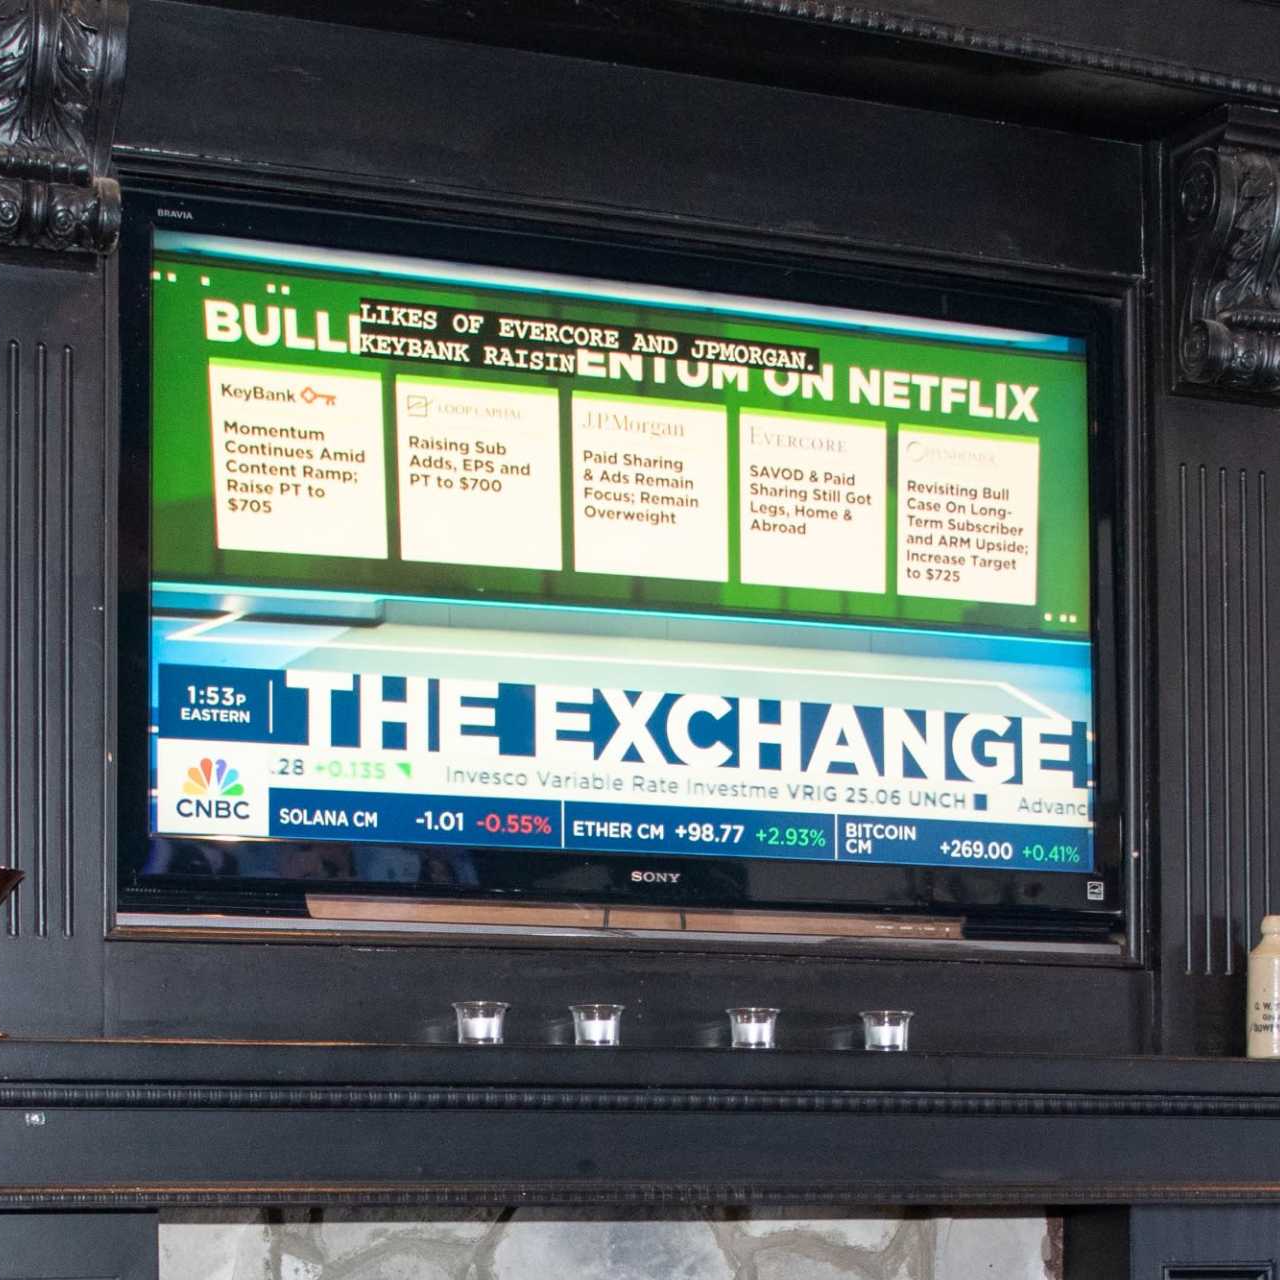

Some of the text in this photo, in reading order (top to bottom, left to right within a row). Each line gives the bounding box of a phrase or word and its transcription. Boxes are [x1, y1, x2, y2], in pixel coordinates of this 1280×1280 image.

[157, 208, 193, 220] BRAVIA
[359, 303, 815, 370] LIKES OF EVERCORE AND JPMORGAN.
[360, 333, 575, 374] KEYBANK RAISIN
[221, 383, 296, 404] KeyBank
[849, 366, 1039, 422] NETFLIX
[224, 420, 325, 441] Momentum
[225, 440, 366, 464] Continues Amid
[409, 436, 506, 456] Raising Sub
[226, 459, 358, 484] Content Ramp;
[410, 454, 531, 477] Adds, EPS and
[583, 450, 684, 473] Paid Sharing
[410, 473, 502, 494] PT to $700
[583, 469, 694, 490] & Ads Remain
[749, 464, 856, 486] SAVOD & Paid
[227, 479, 325, 499] Raise PT to
[584, 488, 699, 508] Focus; Remain
[749, 483, 872, 506] Sharing Still Got
[907, 480, 1010, 501] Revisiting Bull
[227, 498, 272, 514] $705
[584, 505, 676, 526] Overweight
[749, 501, 853, 521] Legs, Home &
[907, 499, 1012, 520] Case On Long-
[750, 519, 807, 535] Abroad
[907, 515, 1024, 537] Term Subscriber
[907, 533, 1029, 556] and ARM Upside;
[907, 550, 1017, 573] Increase Target
[907, 567, 961, 583] to $725
[181, 708, 250, 724] EASTERN
[287, 670, 1074, 787] THE EXCHANGE
[446, 765, 528, 787] Invesco
[536, 771, 624, 792] Variable
[633, 776, 679, 794] Rate
[687, 779, 779, 800] Investme
[787, 783, 838, 802] VRIG
[845, 787, 901, 807] 25.06
[908, 790, 966, 810] UNCH
[1018, 796, 1088, 817] Advanc
[176, 799, 250, 820] CNBC
[280, 808, 552, 835] SOLANA CM -1.01 -0.55%
[573, 820, 826, 848] ETHER CM +98.77 +2.93%
[845, 824, 916, 842] BITCOIN
[845, 839, 872, 855] CM
[939, 840, 1080, 864] +269.00 +0.41%
[631, 871, 680, 883] SONY
